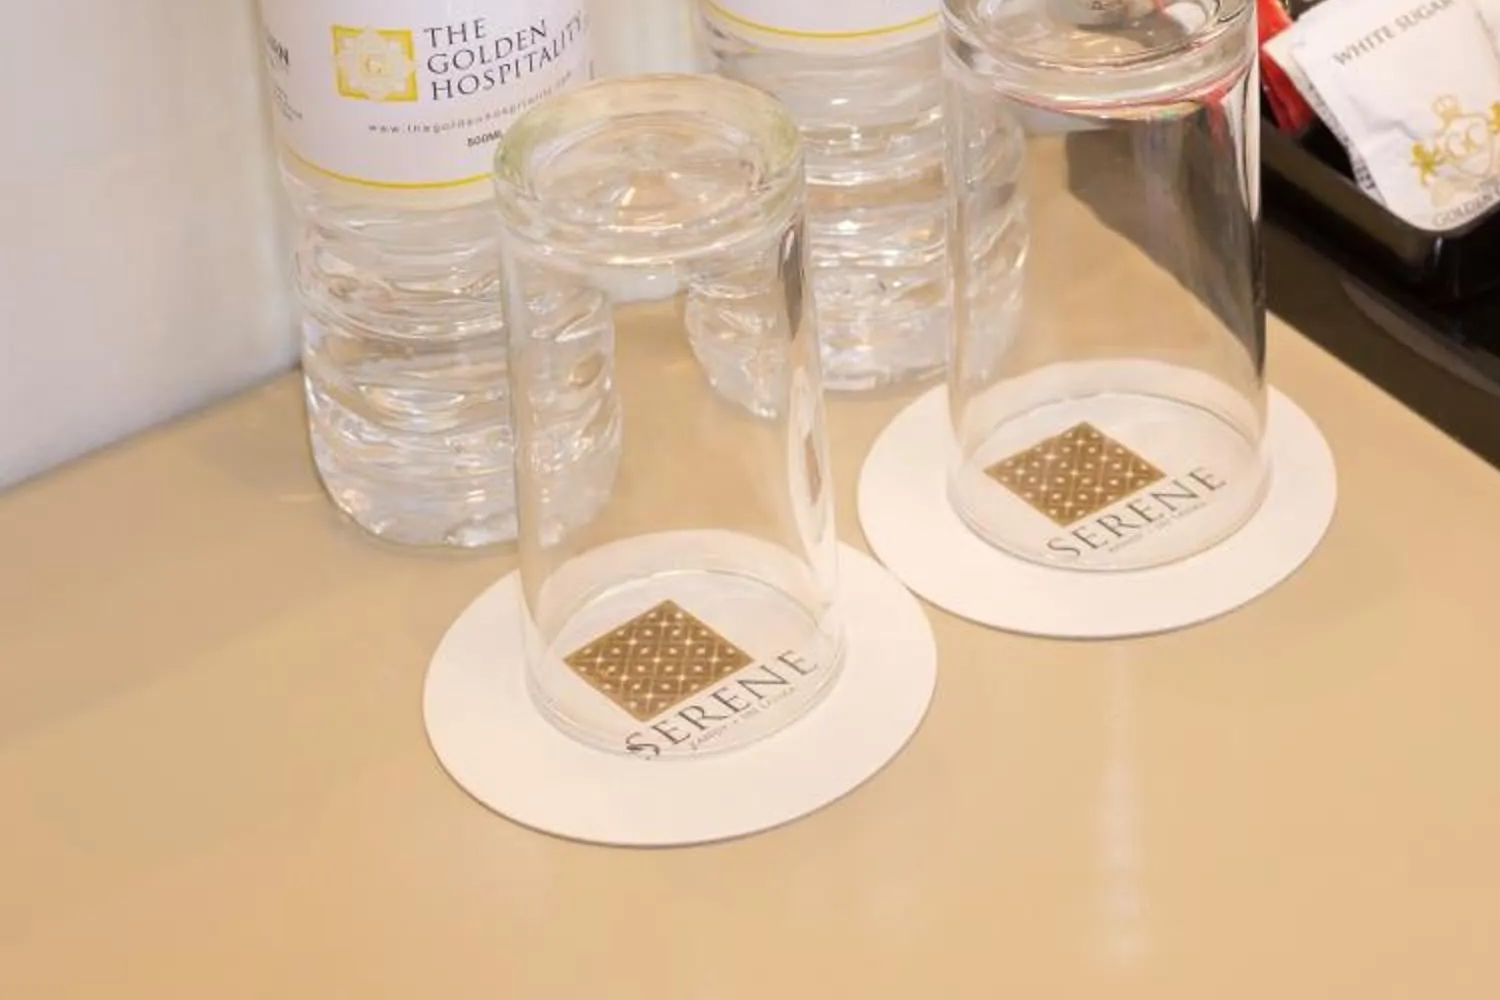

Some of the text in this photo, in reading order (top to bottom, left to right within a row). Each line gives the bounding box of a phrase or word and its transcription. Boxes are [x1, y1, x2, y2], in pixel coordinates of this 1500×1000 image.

[422, 17, 487, 49] THE
[427, 19, 548, 75] GOLDEN
[1331, 25, 1397, 66] WHITE
[1046, 466, 1227, 557] SERENE
[625, 649, 818, 760] SERENE
